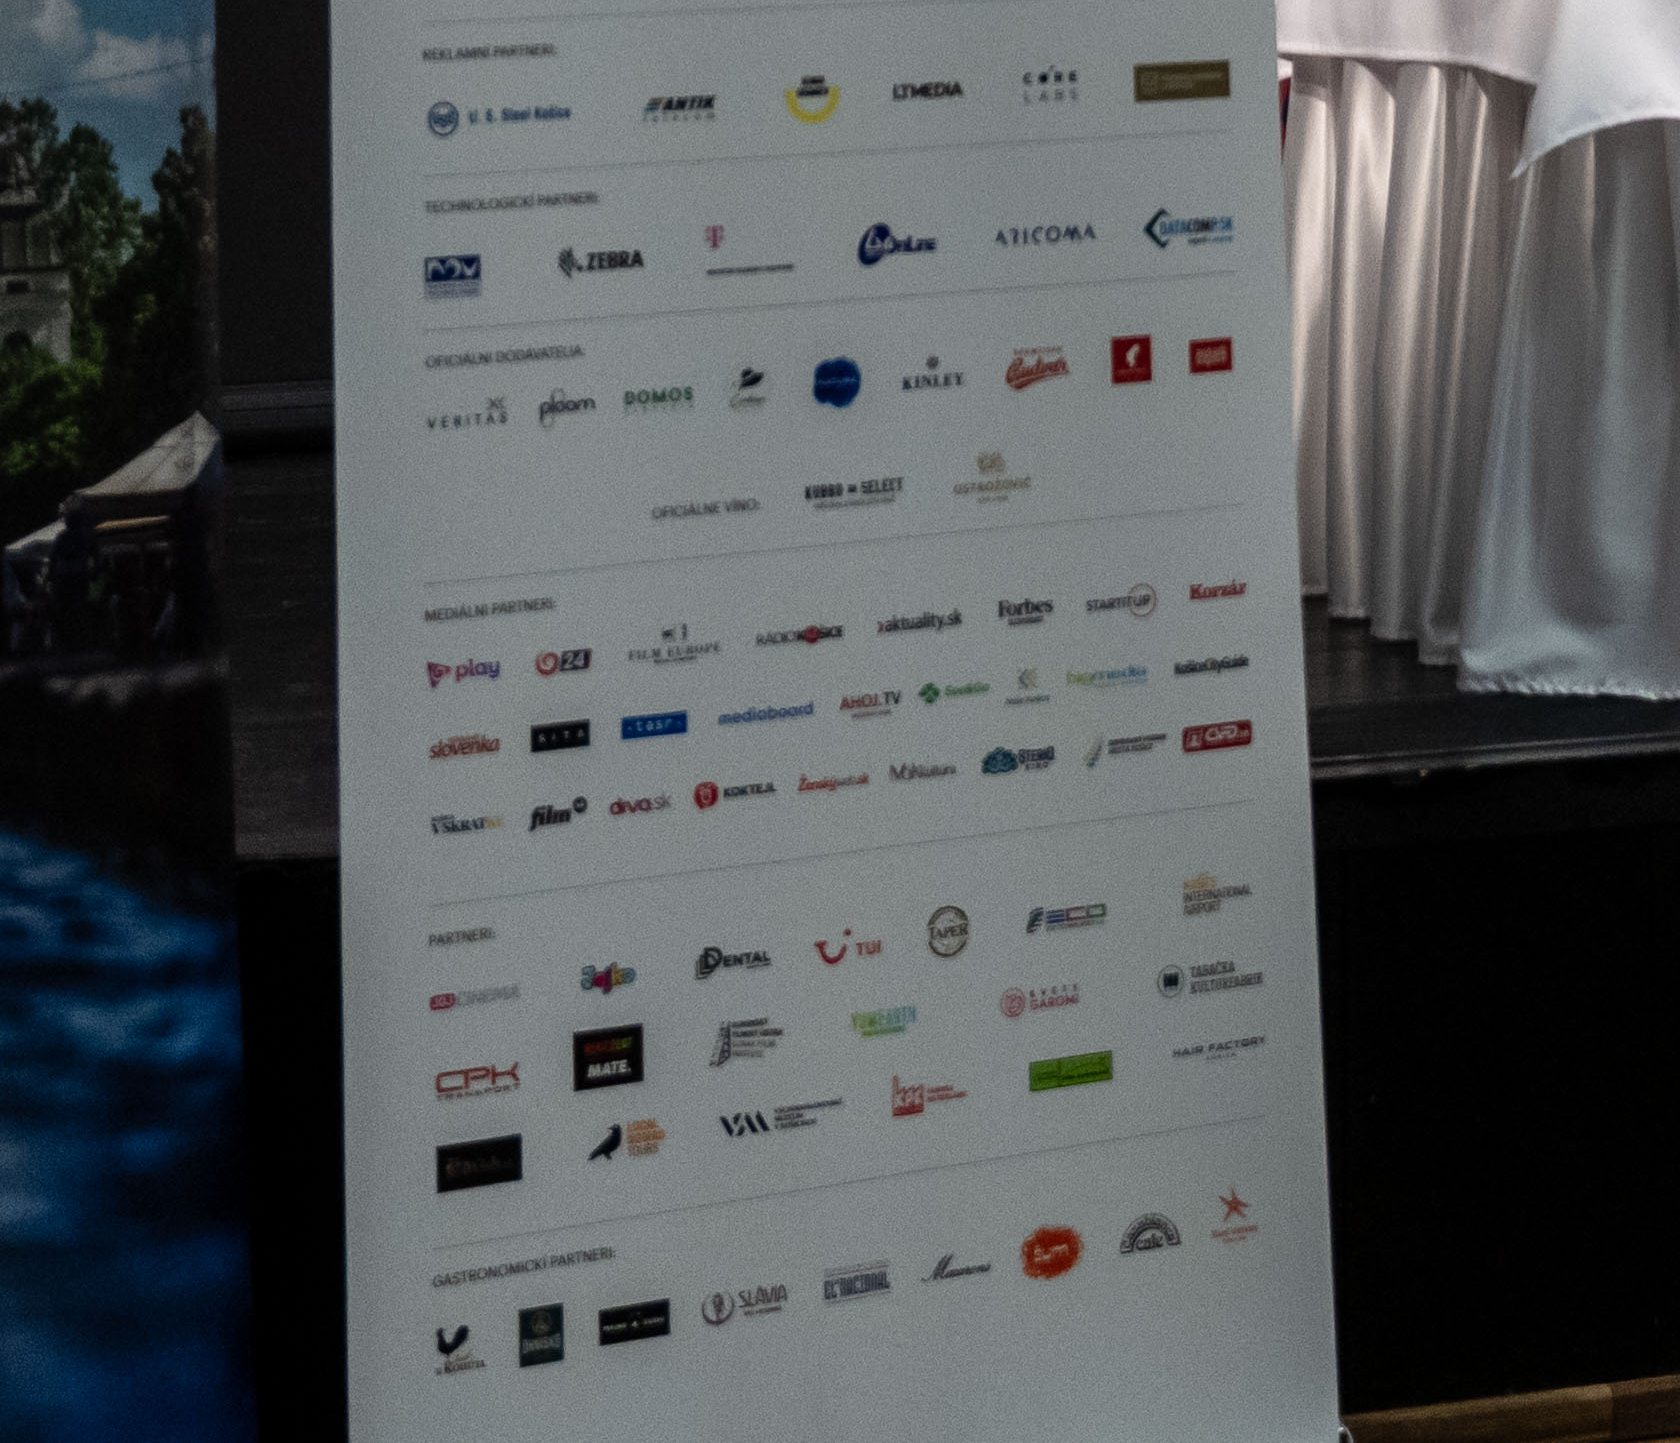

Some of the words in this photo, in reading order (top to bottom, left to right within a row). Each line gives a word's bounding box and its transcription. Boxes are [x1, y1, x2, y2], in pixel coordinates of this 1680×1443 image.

[584, 249, 644, 272] ZEBRA
[901, 373, 964, 391] KINLEY
[623, 385, 694, 406] DOMOS
[426, 411, 508, 430] VERITAS
[998, 599, 1054, 618] Forbes
[883, 608, 963, 633] aktuality.sk
[454, 658, 500, 683] play
[560, 651, 590, 670] 24
